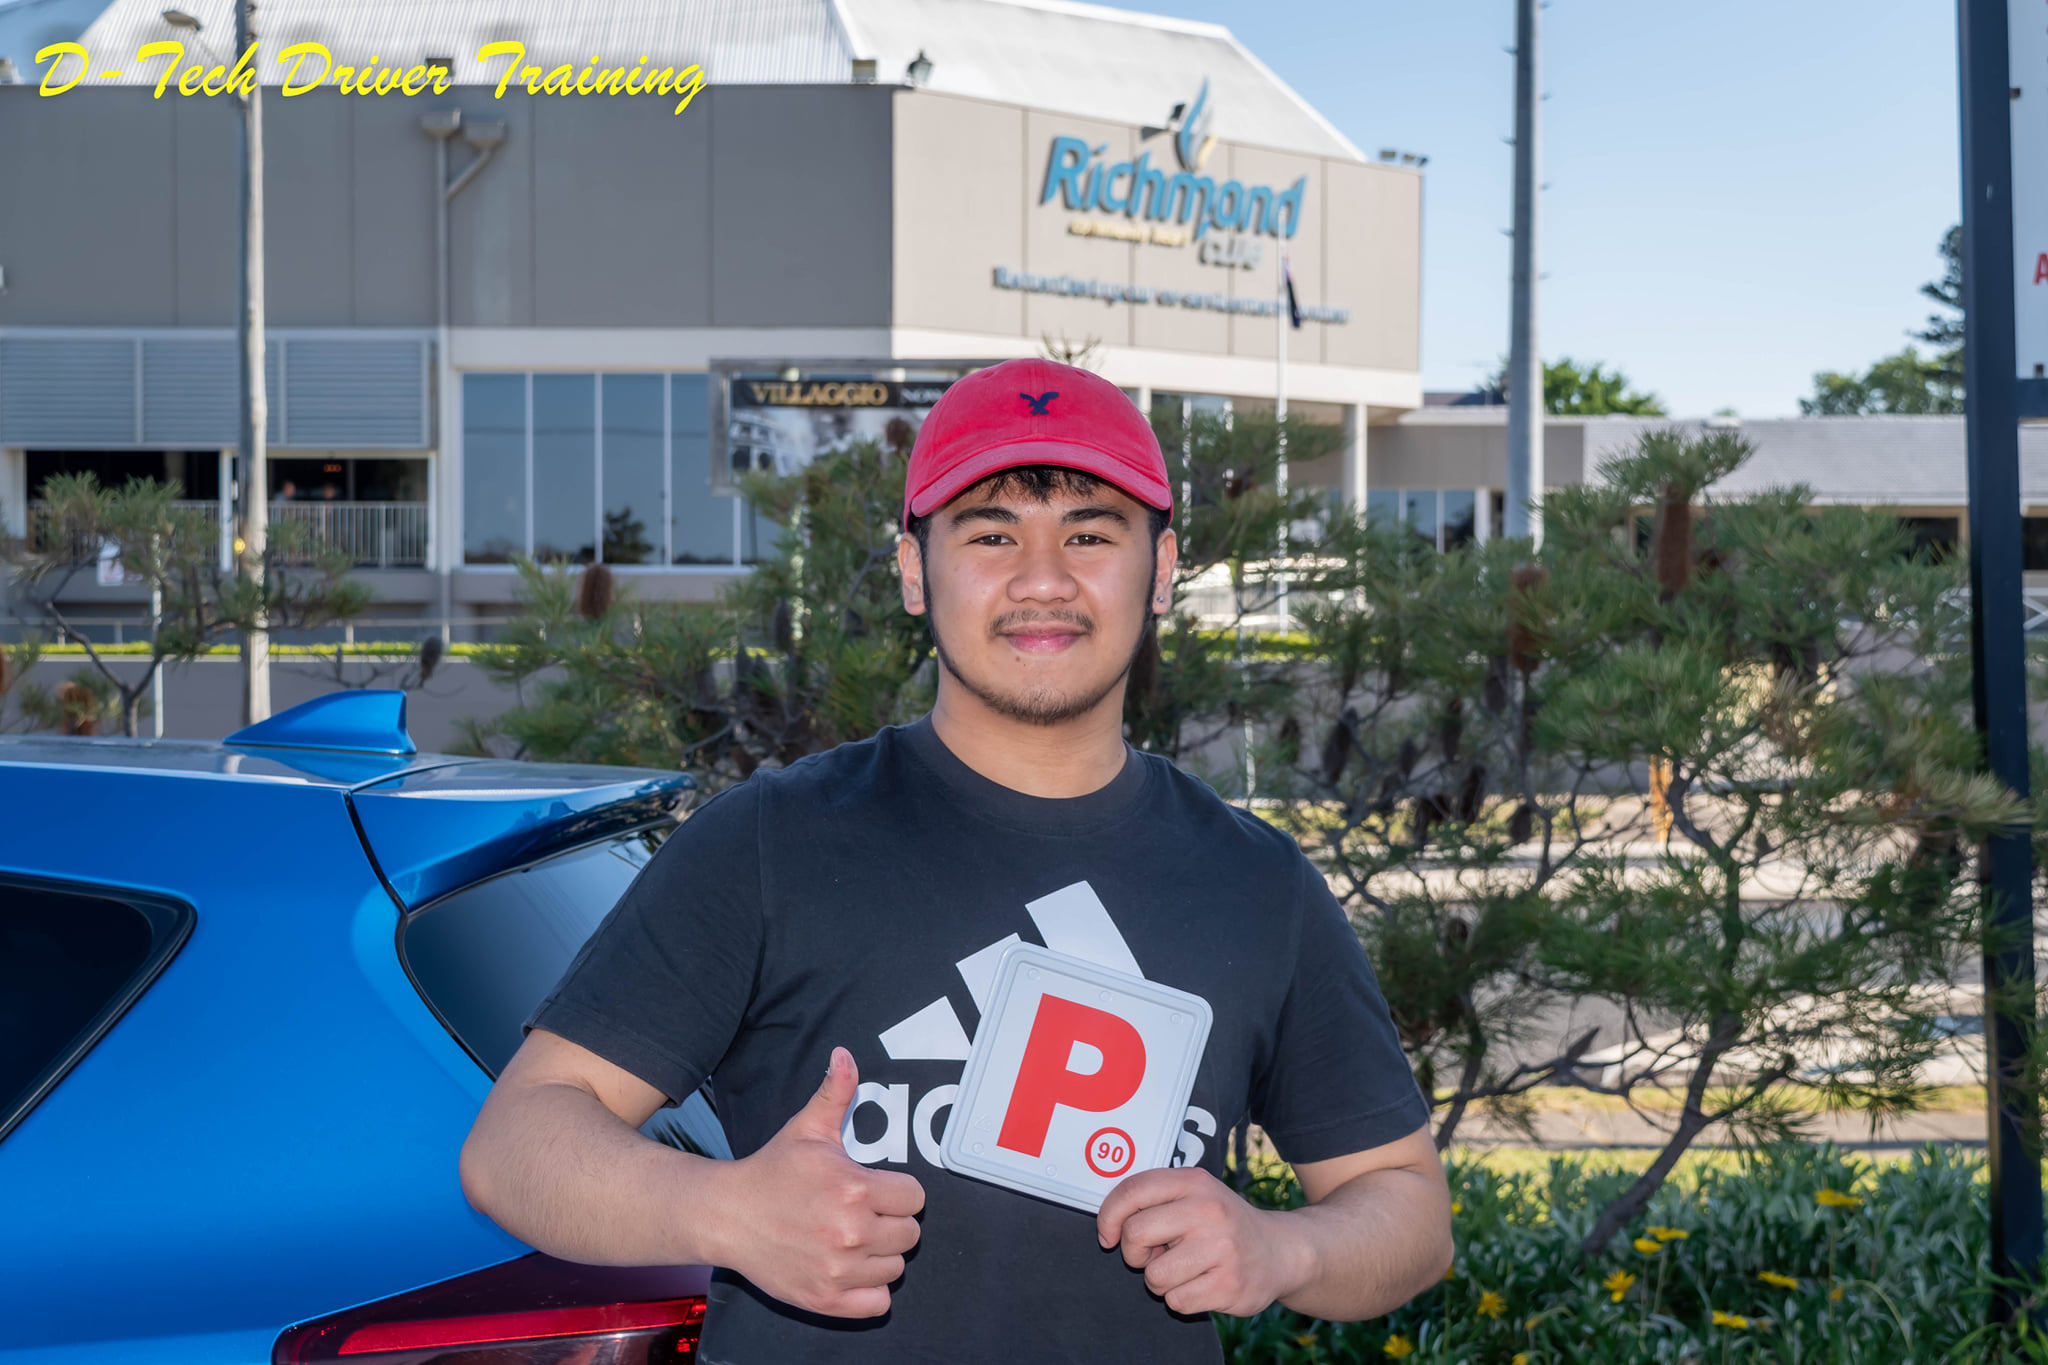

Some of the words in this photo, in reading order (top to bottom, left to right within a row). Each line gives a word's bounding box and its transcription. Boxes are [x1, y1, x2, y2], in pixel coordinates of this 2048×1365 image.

[1041, 136, 1306, 242] Richmond
[753, 383, 888, 405] VILLAGGIO
[996, 992, 1147, 1159] P
[1097, 1141, 1124, 1163] 90
